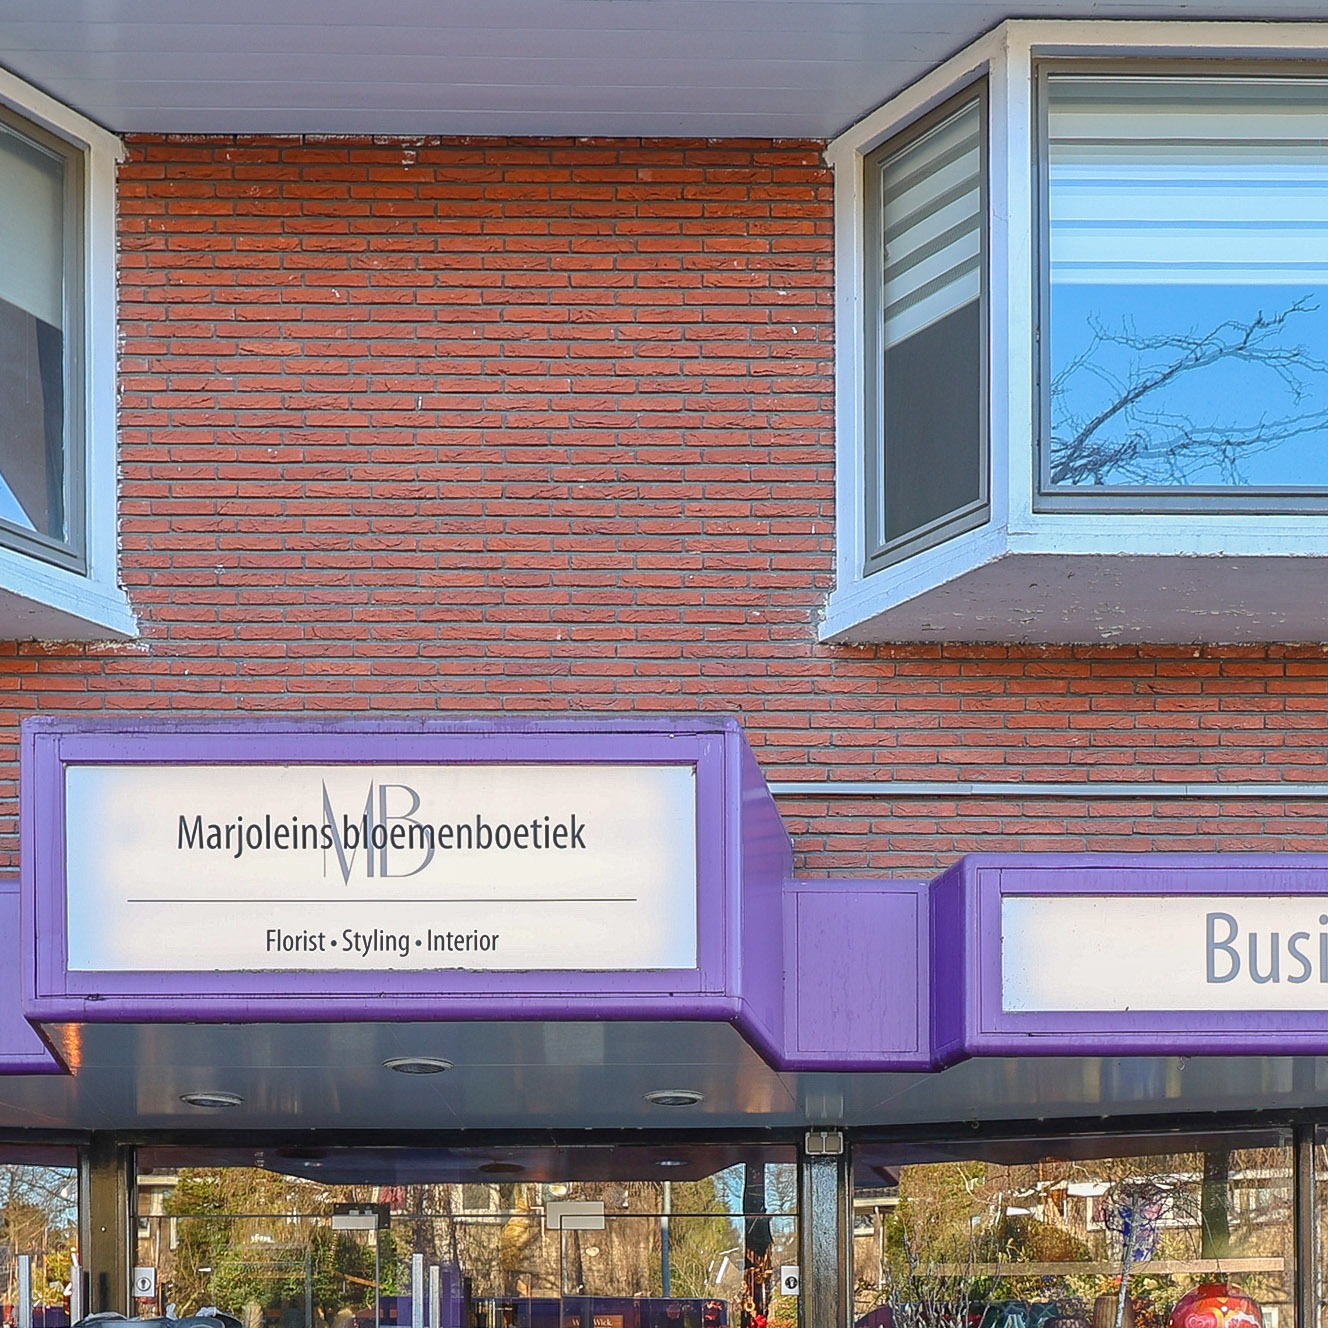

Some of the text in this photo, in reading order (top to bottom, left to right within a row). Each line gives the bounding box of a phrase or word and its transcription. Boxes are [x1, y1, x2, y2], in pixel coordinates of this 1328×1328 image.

[177, 813, 587, 859] Marjoleins bloemenboetiek
[266, 928, 500, 958] Florist Styling Interior
